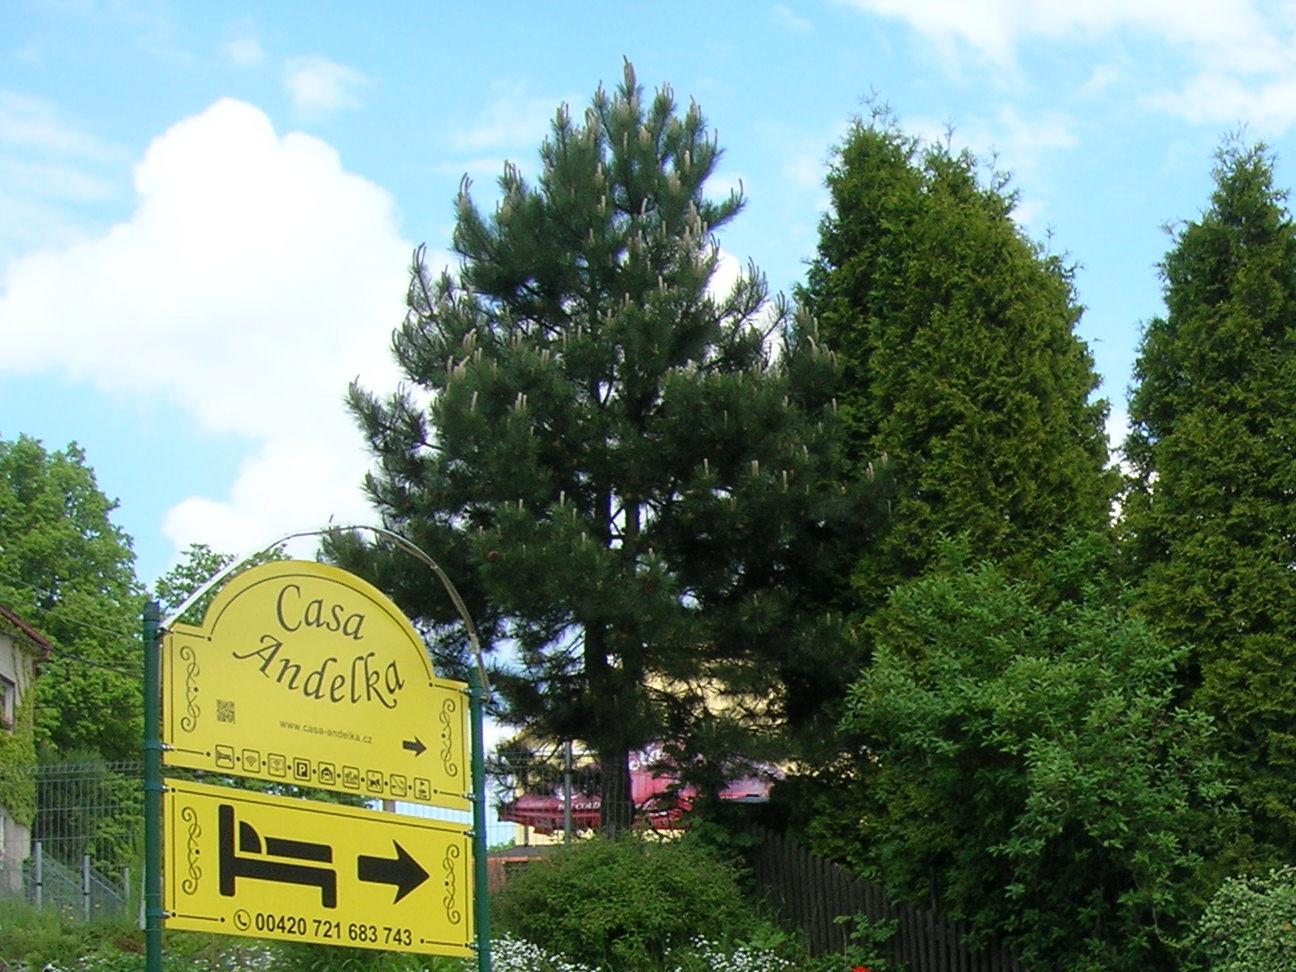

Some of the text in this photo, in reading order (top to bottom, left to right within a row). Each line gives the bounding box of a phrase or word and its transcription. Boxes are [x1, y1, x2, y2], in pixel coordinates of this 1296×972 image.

[276, 584, 366, 640] Casa
[232, 634, 405, 709] Andelka
[279, 720, 373, 744] www.casa-andelka.cz
[255, 912, 412, 946] 00420 721 683 743
